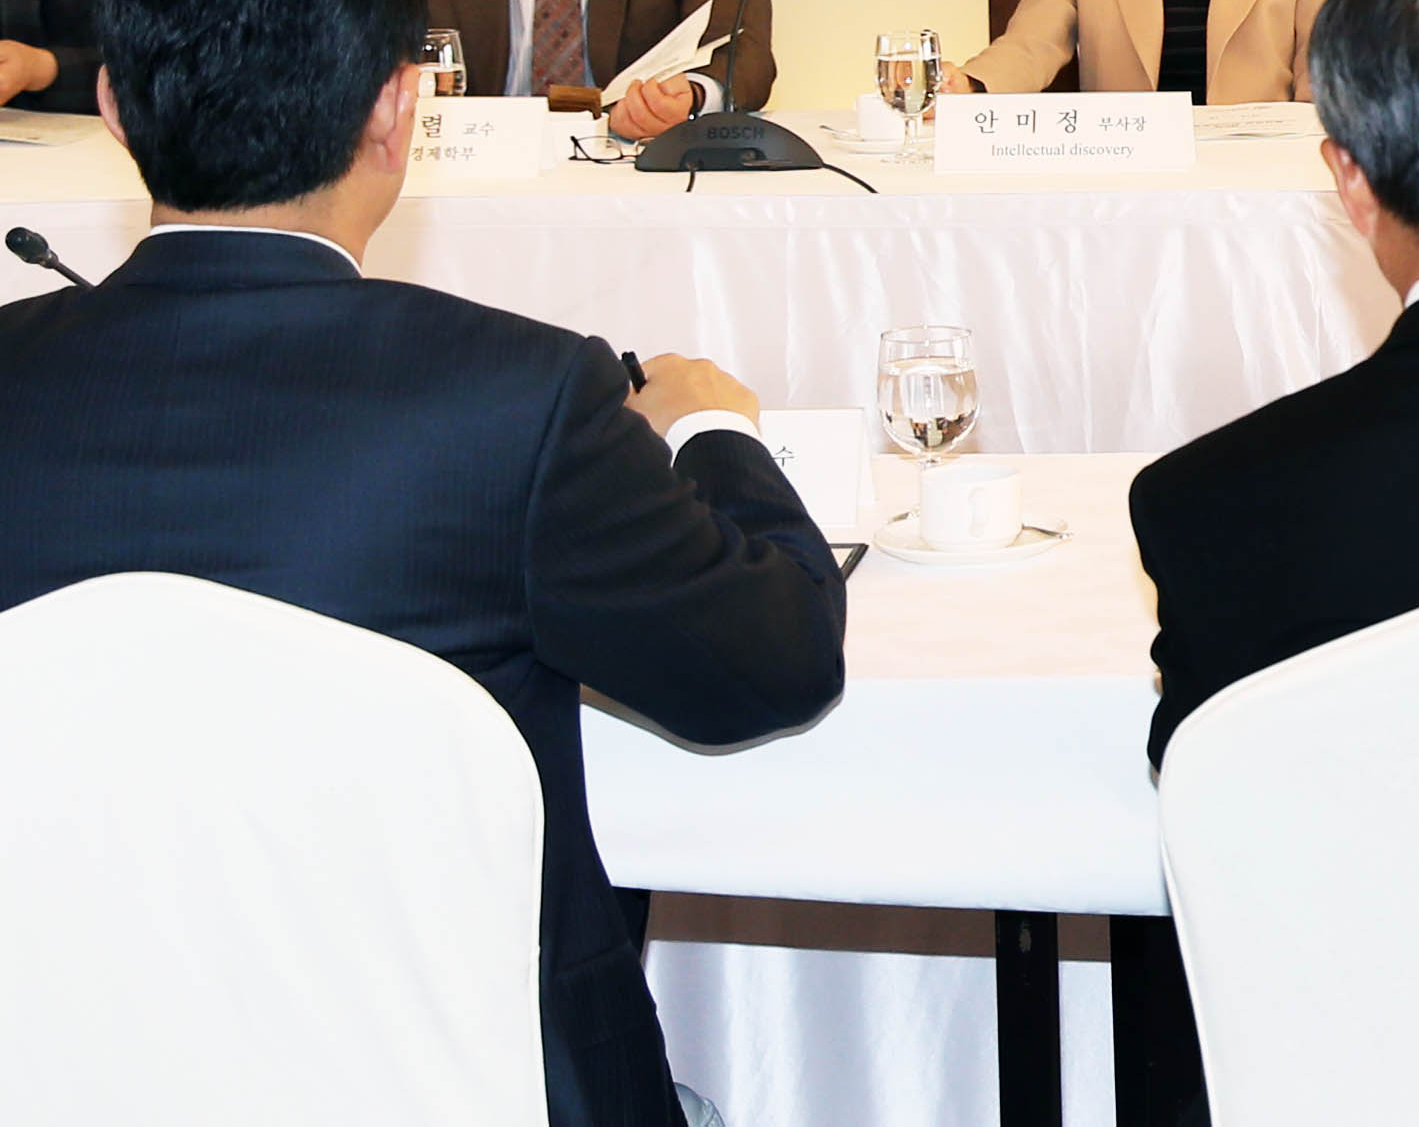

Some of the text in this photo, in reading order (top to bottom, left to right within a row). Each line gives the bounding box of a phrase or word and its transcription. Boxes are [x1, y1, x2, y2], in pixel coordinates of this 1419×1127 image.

[464, 122, 494, 137] 교수
[1098, 116, 1147, 132] 부사장
[706, 126, 765, 140] BOSCH
[992, 143, 1134, 161] Intellectual discovery
